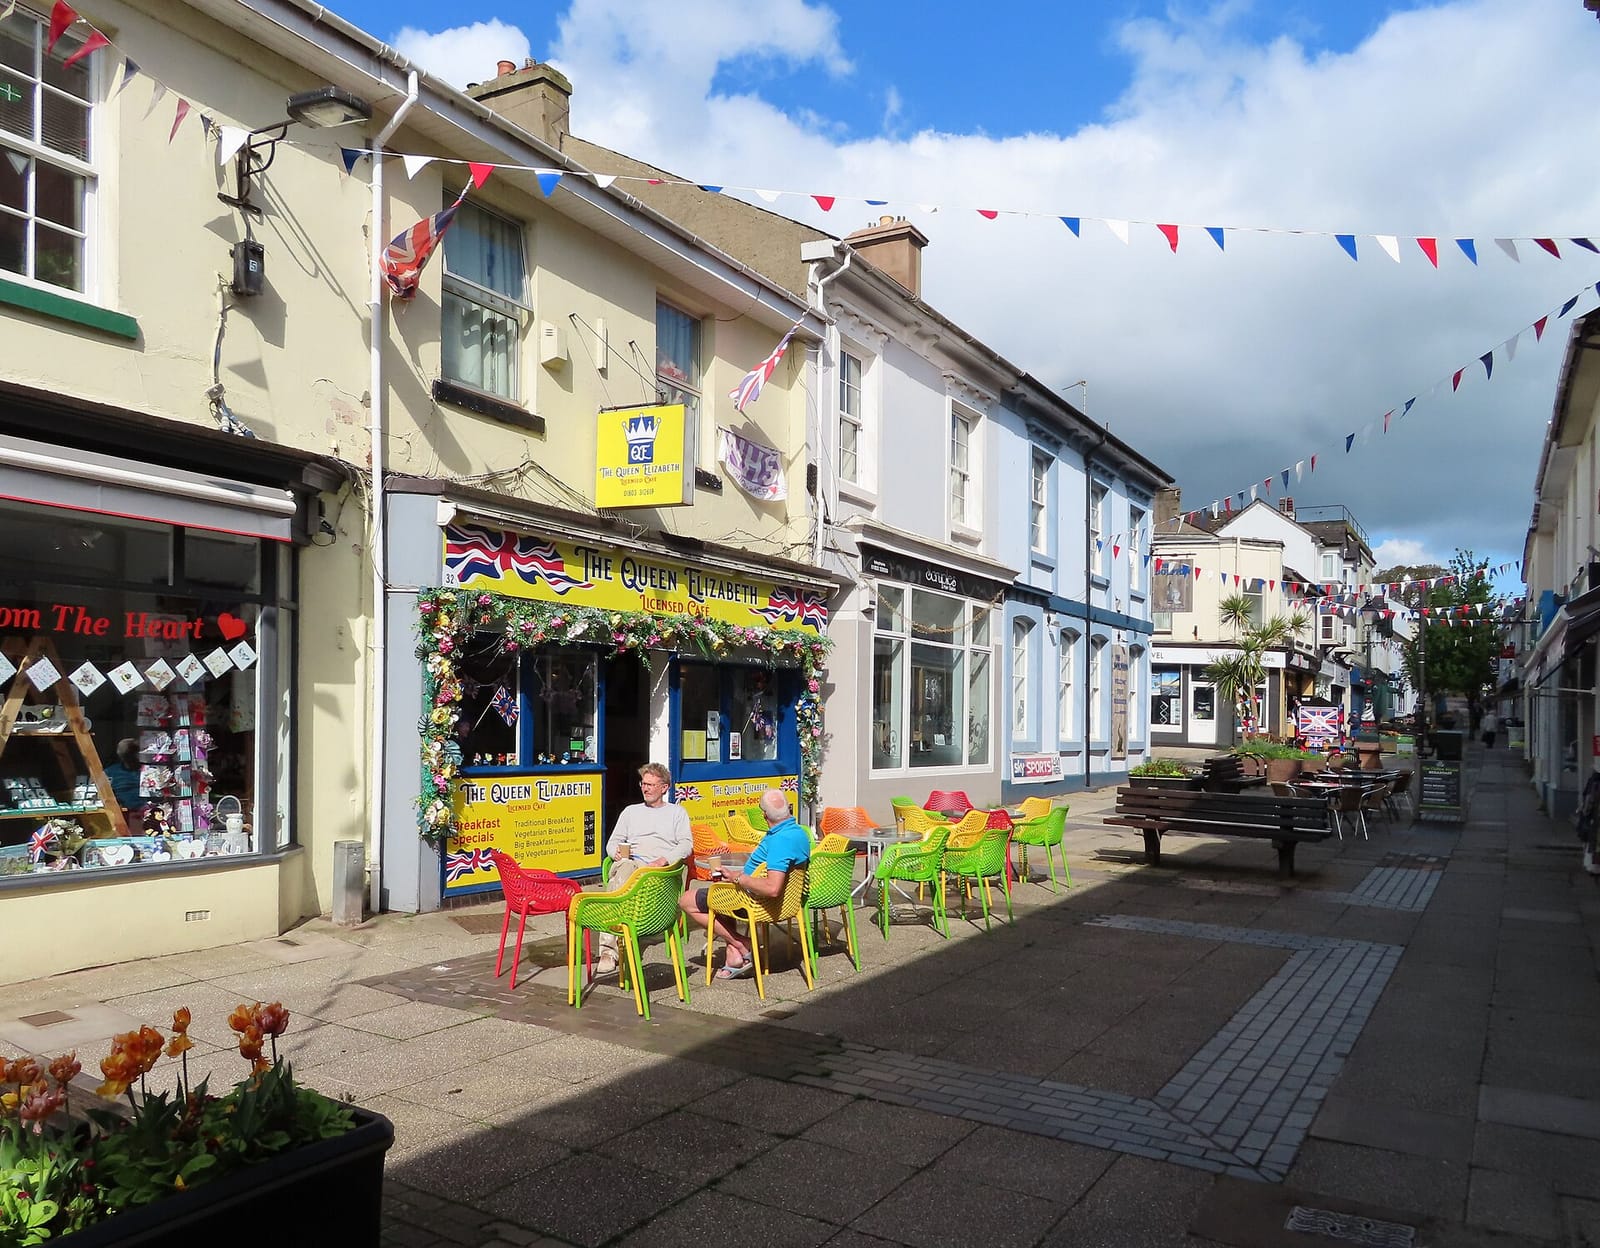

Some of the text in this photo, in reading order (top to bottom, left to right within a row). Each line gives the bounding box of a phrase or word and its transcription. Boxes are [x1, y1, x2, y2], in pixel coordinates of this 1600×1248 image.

[600, 463, 680, 478] THE QUEEN ELIZABETH
[445, 573, 455, 585] 32
[575, 546, 758, 605] THE QUEEN ELIZABETH
[639, 594, 684, 614] LICENSED
[53, 604, 110, 636] The
[124, 612, 204, 640] Heart
[1014, 760, 1025, 777] sky
[1026, 760, 1052, 774] SPORTS
[460, 780, 592, 805] THE QUEEN ELIZABETH
[711, 782, 768, 796] THE QUEEN ELIZABETH
[507, 804, 531, 813] LICENSED
[711, 796, 760, 808] Homemade Spec
[453, 817, 501, 831] Breakfast
[515, 818, 547, 828] Traditional
[547, 815, 575, 826] Breakfast
[453, 832, 494, 847] Specials
[514, 829, 549, 840] Vegetarian
[548, 825, 575, 836] Breakfast
[514, 840, 525, 850] Big
[525, 838, 554, 849] Breakfast
[514, 850, 525, 861] Big
[525, 847, 558, 859] Vegetarian
